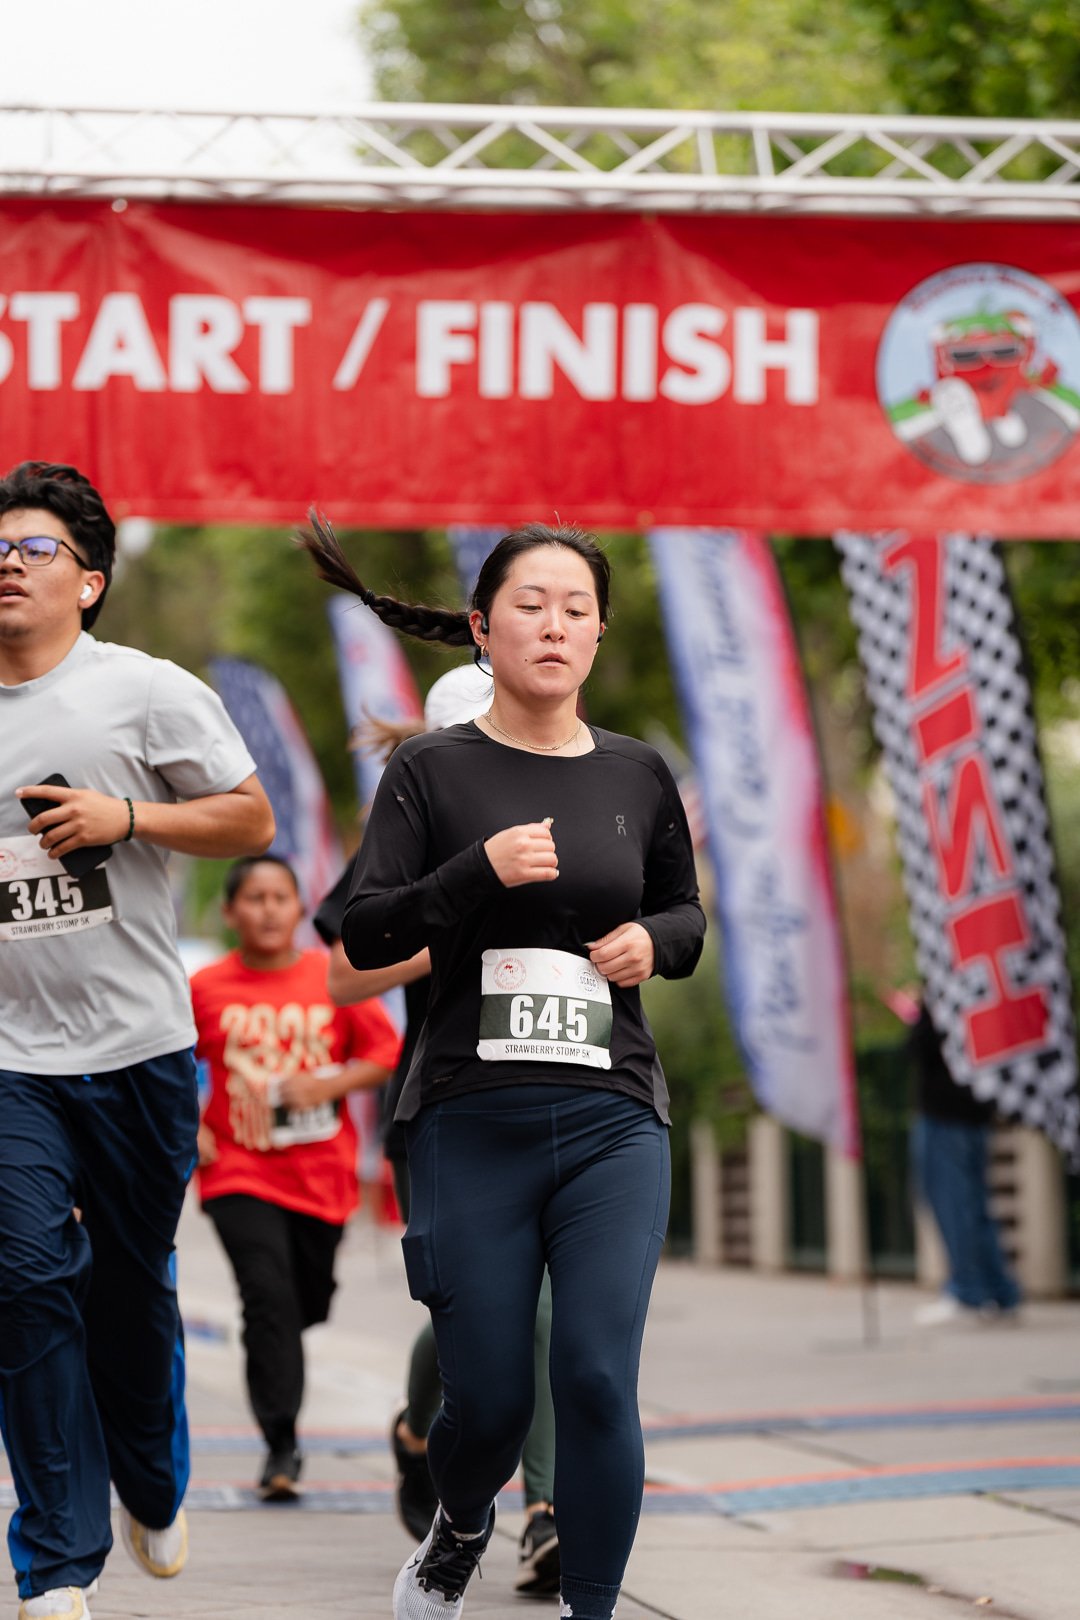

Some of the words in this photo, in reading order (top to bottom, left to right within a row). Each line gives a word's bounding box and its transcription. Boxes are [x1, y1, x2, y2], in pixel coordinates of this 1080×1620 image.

[0, 291, 311, 395] TART
[332, 297, 390, 391] /
[416, 301, 819, 405] FINISH
[880, 535, 1050, 1066] NISH
[8, 874, 84, 921] 345
[11, 922, 55, 936] STRAWBERRY
[56, 919, 79, 930] STOMP
[80, 916, 90, 925] 5K
[509, 994, 589, 1043] 645
[504, 1044, 554, 1056] STRAWBERRY
[556, 1046, 580, 1057] STOMP
[581, 1048, 591, 1059] 5K
